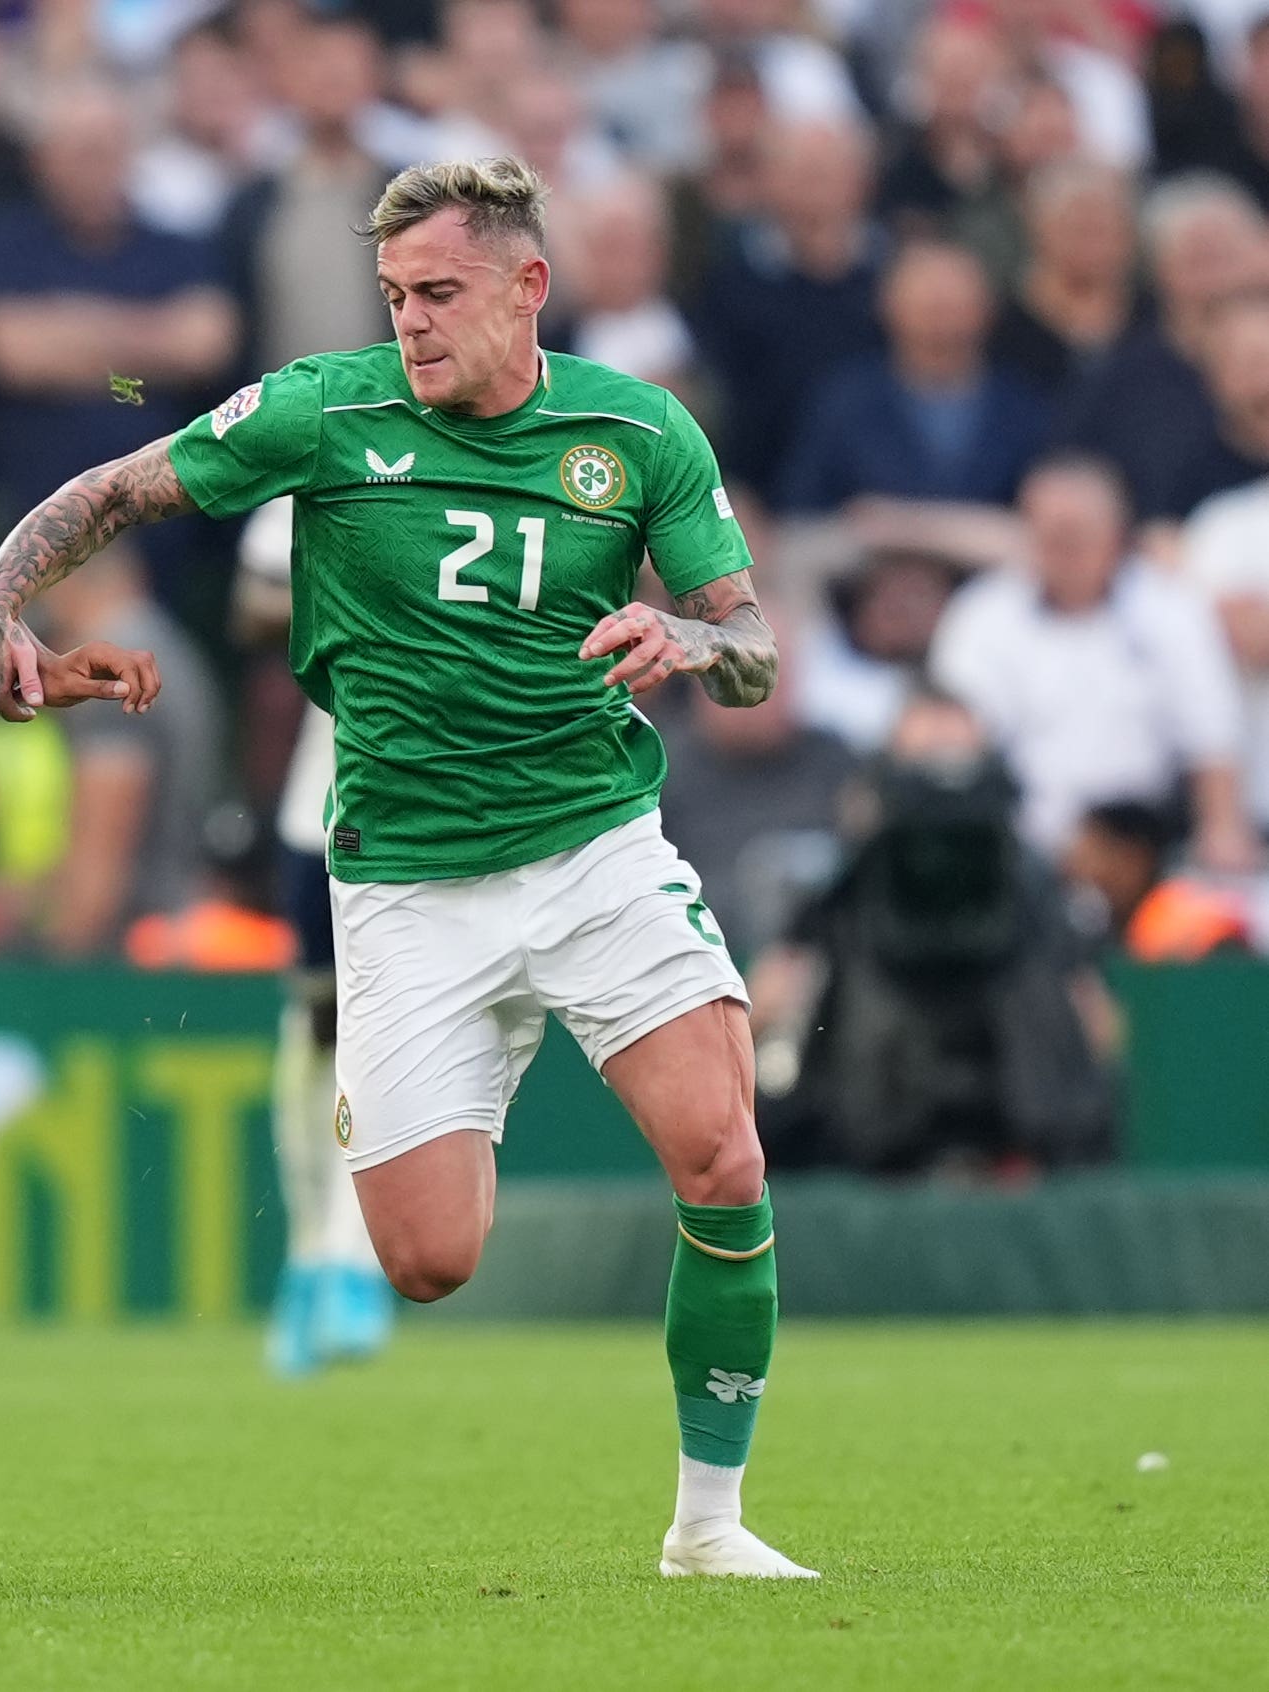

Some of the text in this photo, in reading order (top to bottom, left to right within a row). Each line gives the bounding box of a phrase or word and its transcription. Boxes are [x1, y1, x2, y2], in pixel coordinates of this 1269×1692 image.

[565, 449, 616, 468] IRELAND
[365, 476, 413, 484] CASTORE
[437, 509, 545, 611] 21
